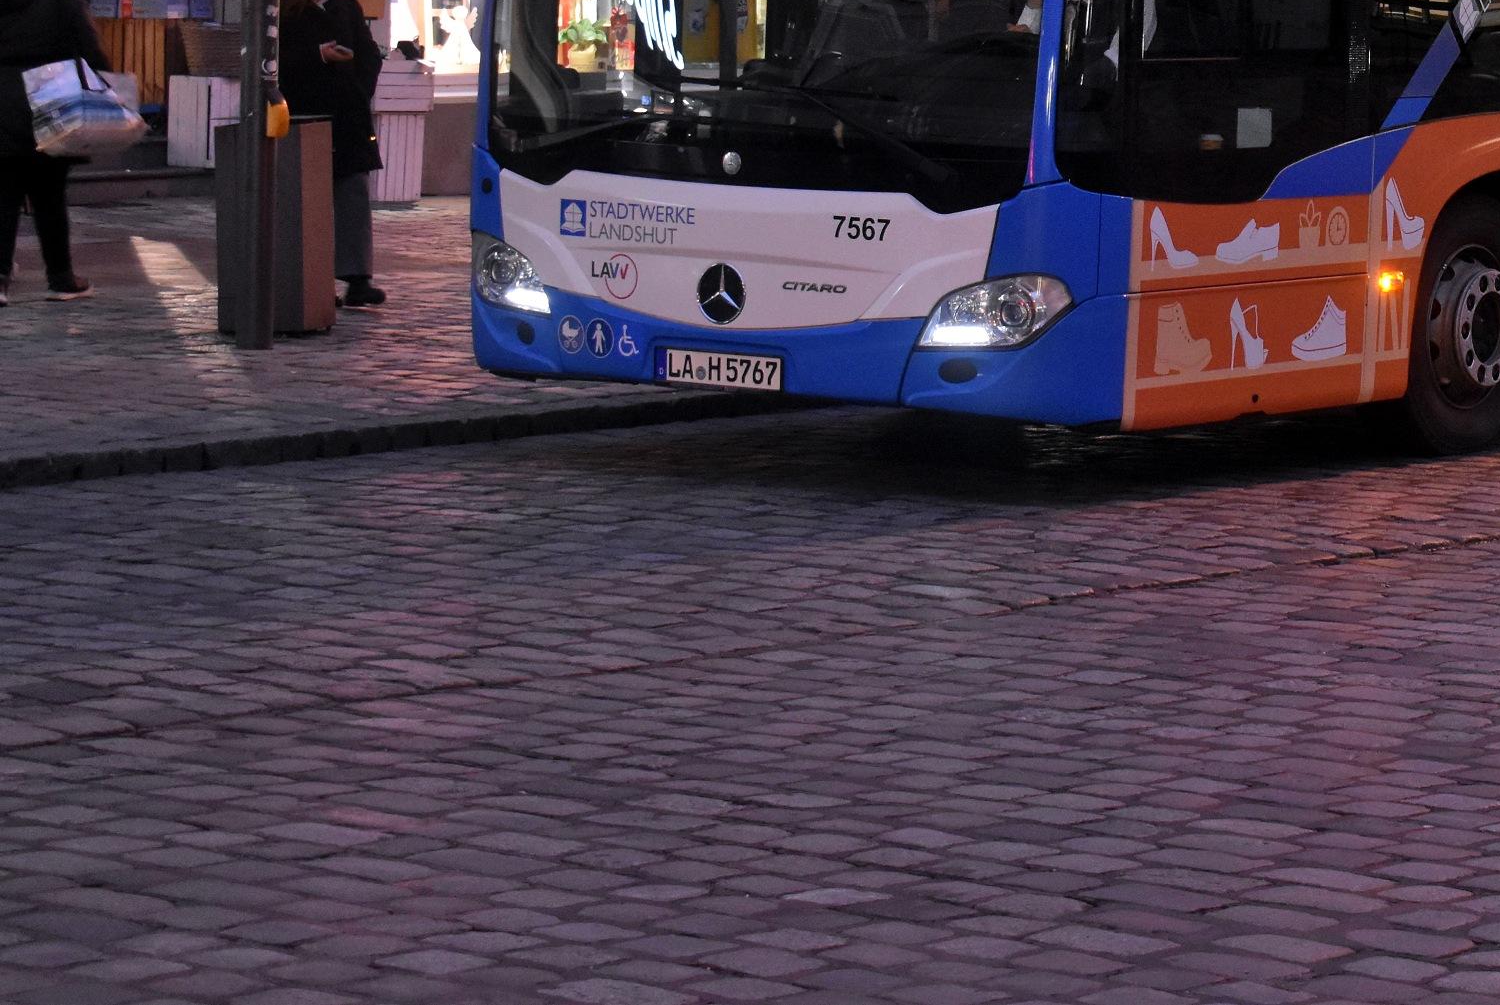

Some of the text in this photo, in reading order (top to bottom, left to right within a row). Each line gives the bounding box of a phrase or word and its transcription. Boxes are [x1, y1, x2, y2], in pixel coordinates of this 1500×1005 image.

[590, 200, 696, 225] STADTWERKE
[589, 222, 678, 245] LANDSHUT
[833, 215, 891, 242] 7567
[782, 281, 848, 294] CITARO
[668, 352, 694, 379] LA
[708, 356, 721, 381] H
[726, 357, 778, 386] 5767
